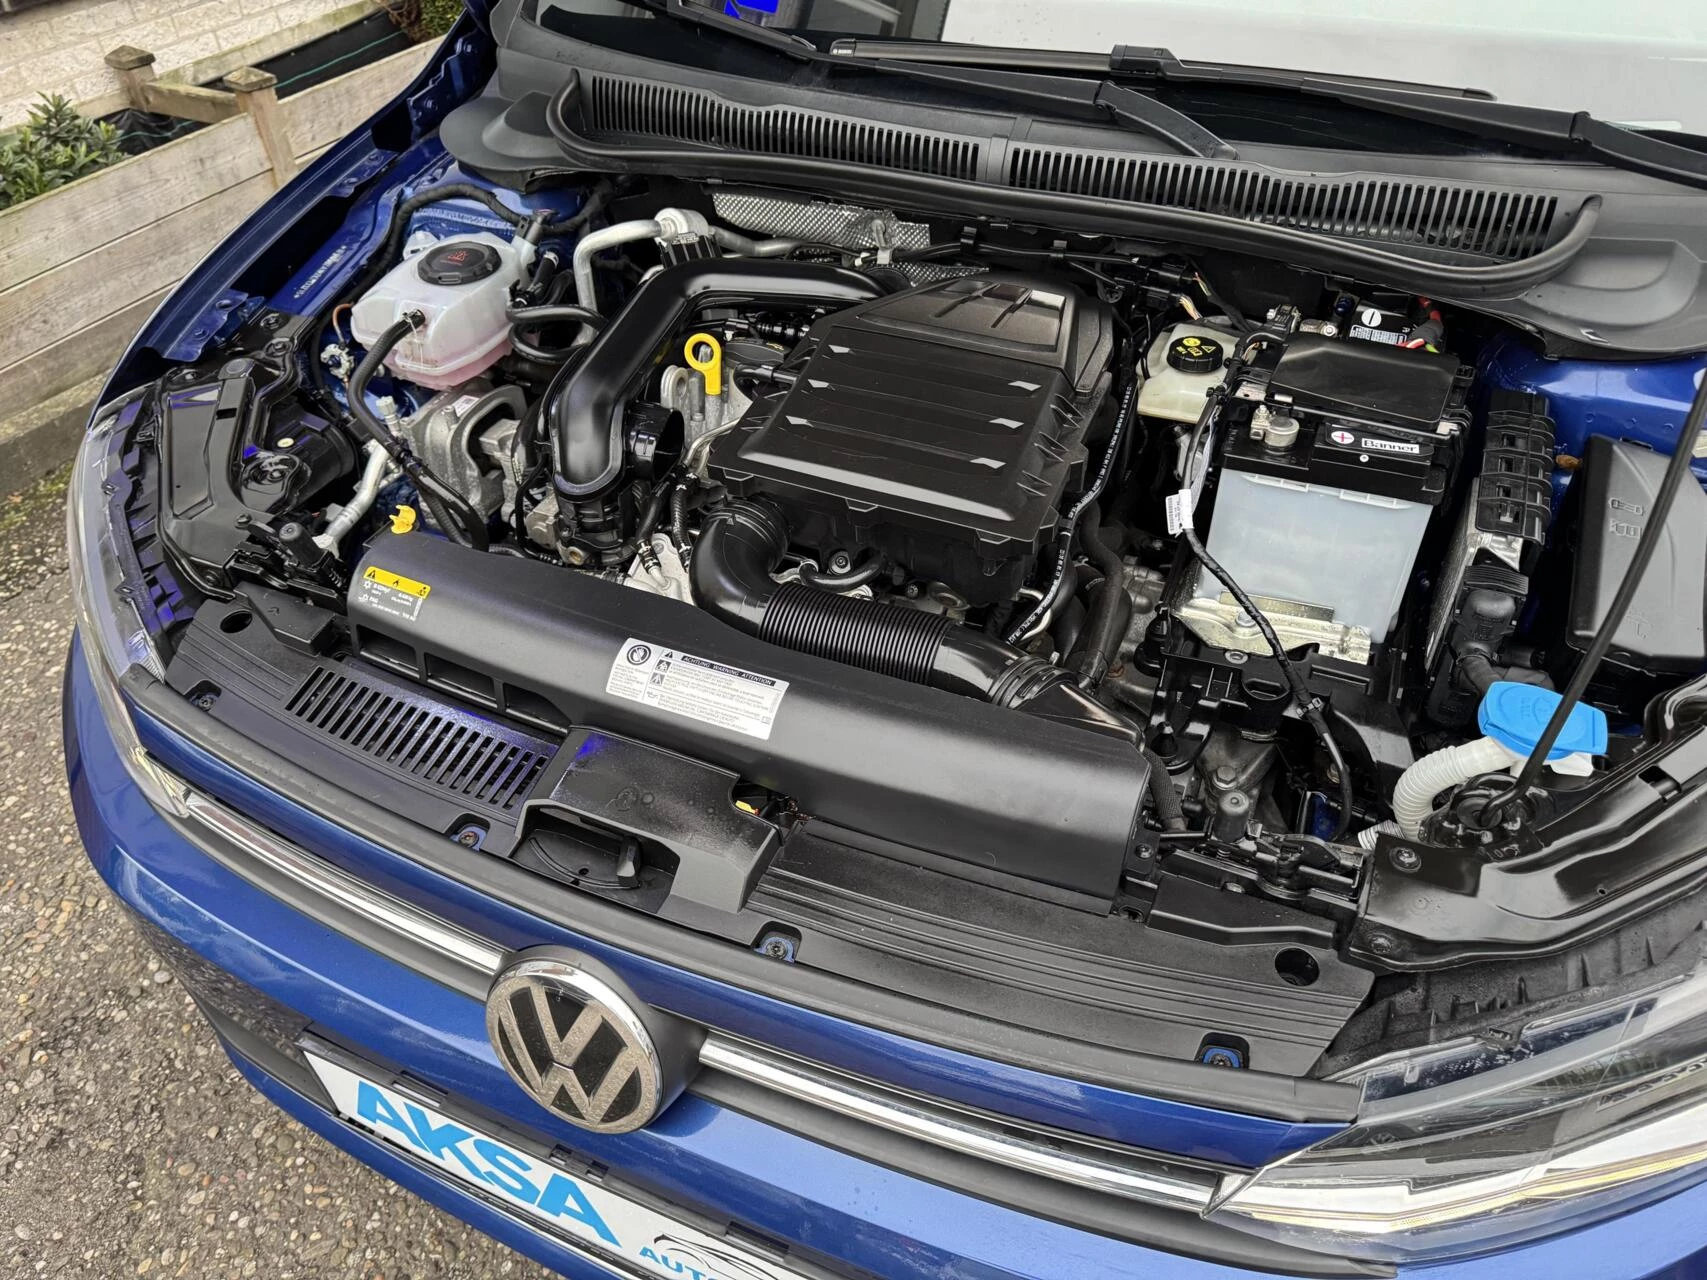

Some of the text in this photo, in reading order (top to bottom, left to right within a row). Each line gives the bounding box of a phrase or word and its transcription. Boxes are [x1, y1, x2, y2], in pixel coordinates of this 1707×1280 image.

[1363, 439, 1418, 452] Banner
[683, 656, 773, 686] ACHTUNG WARNING ATTENTION
[357, 1080, 621, 1248] AKSA
[639, 1246, 718, 1280] AUT
